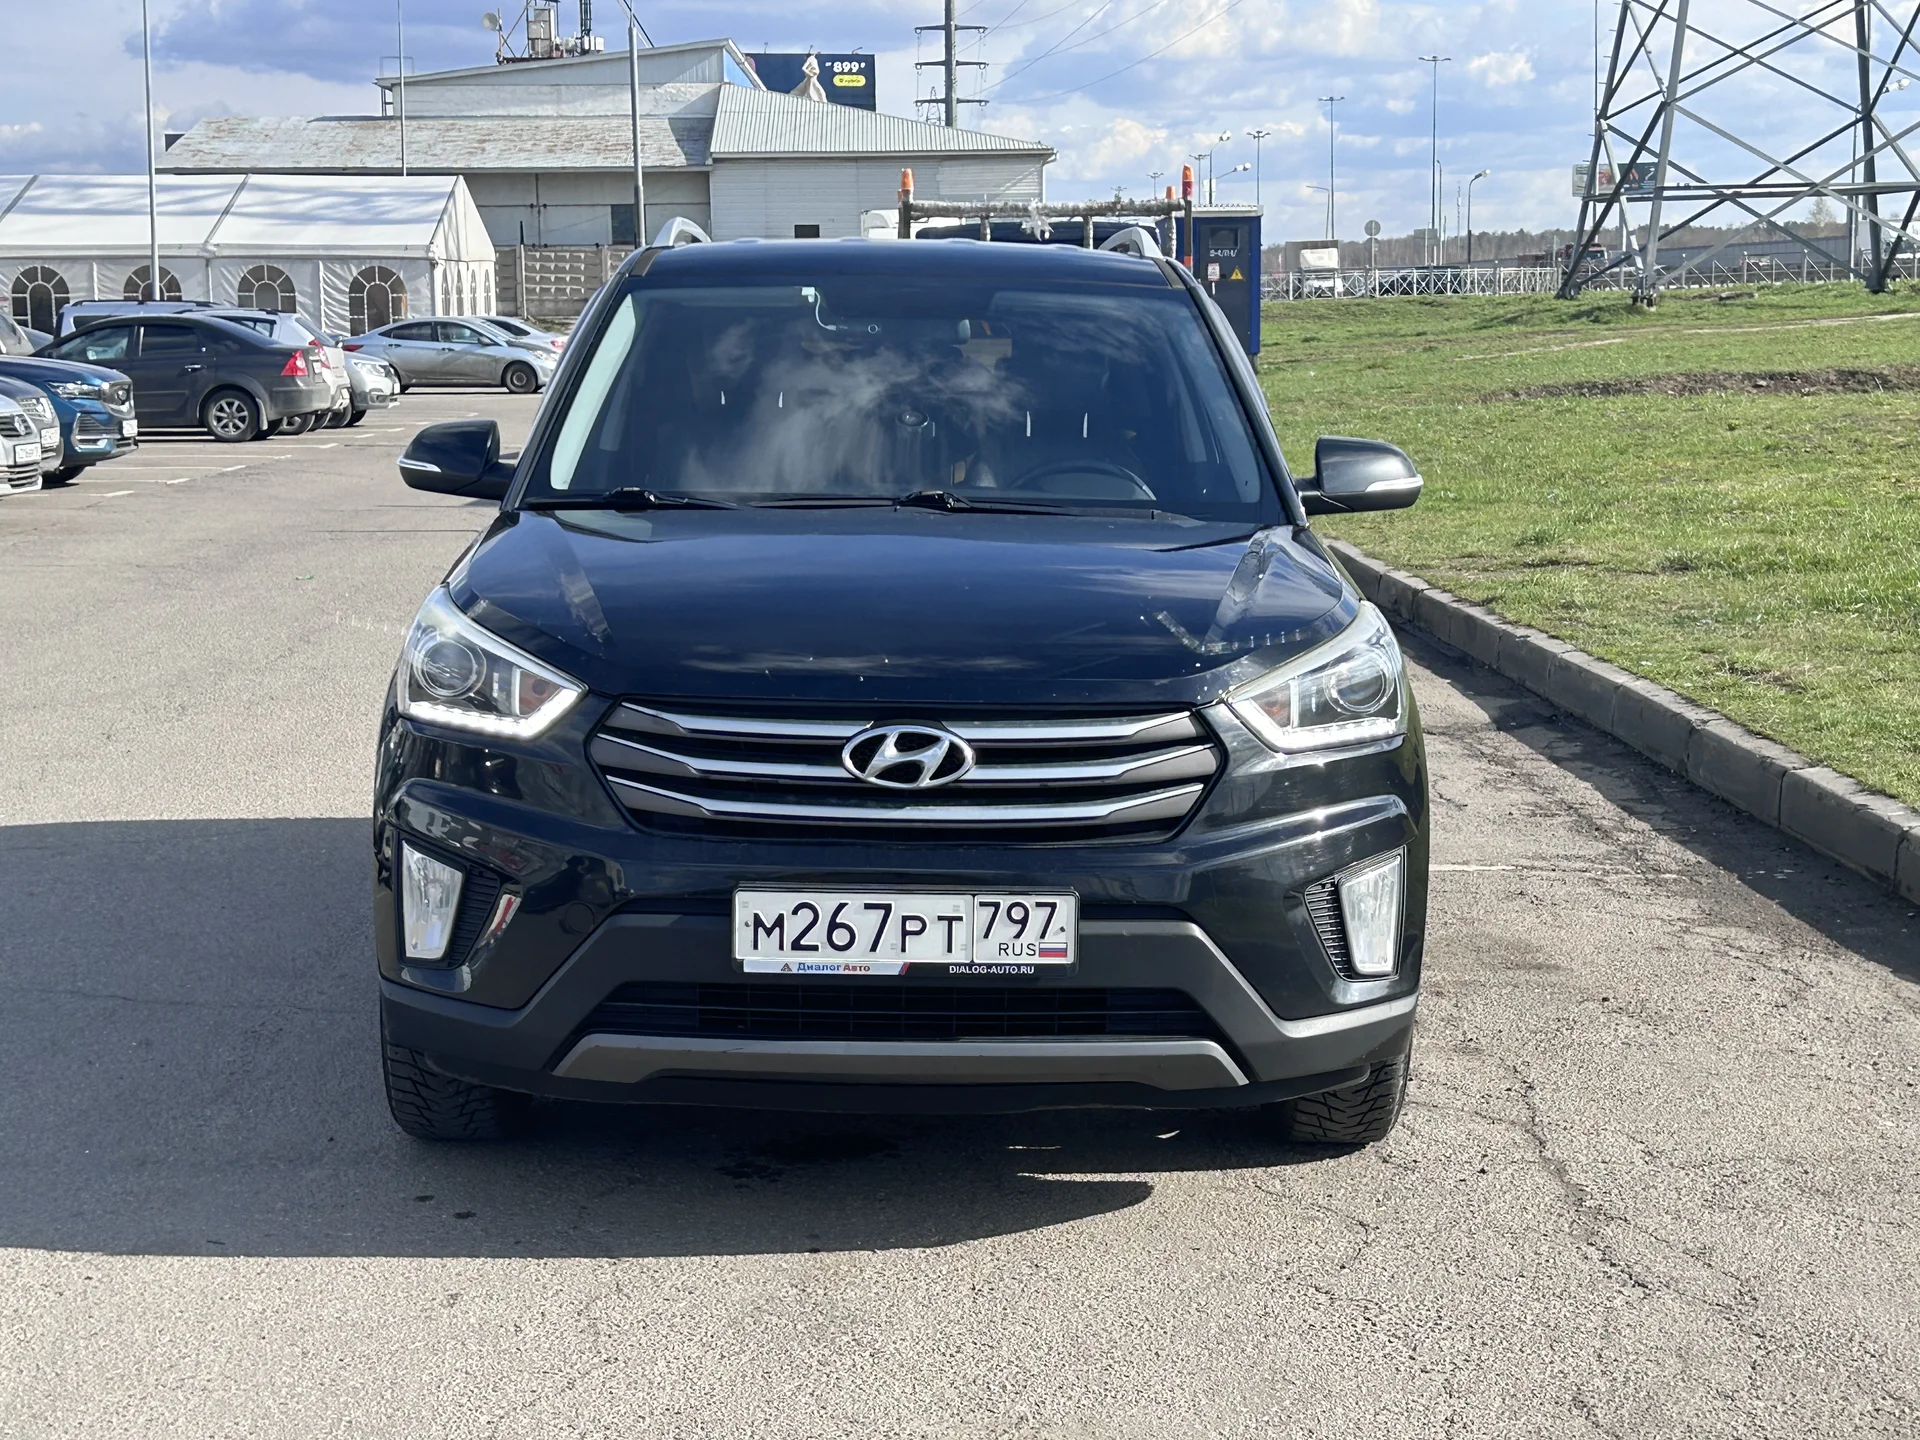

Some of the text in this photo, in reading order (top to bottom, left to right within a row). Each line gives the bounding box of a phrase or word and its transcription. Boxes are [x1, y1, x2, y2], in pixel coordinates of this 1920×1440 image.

[978, 901, 1057, 939] 797
[998, 943, 1036, 957] RUS
[949, 965, 1035, 974] DIALOG-AUTO.RU
